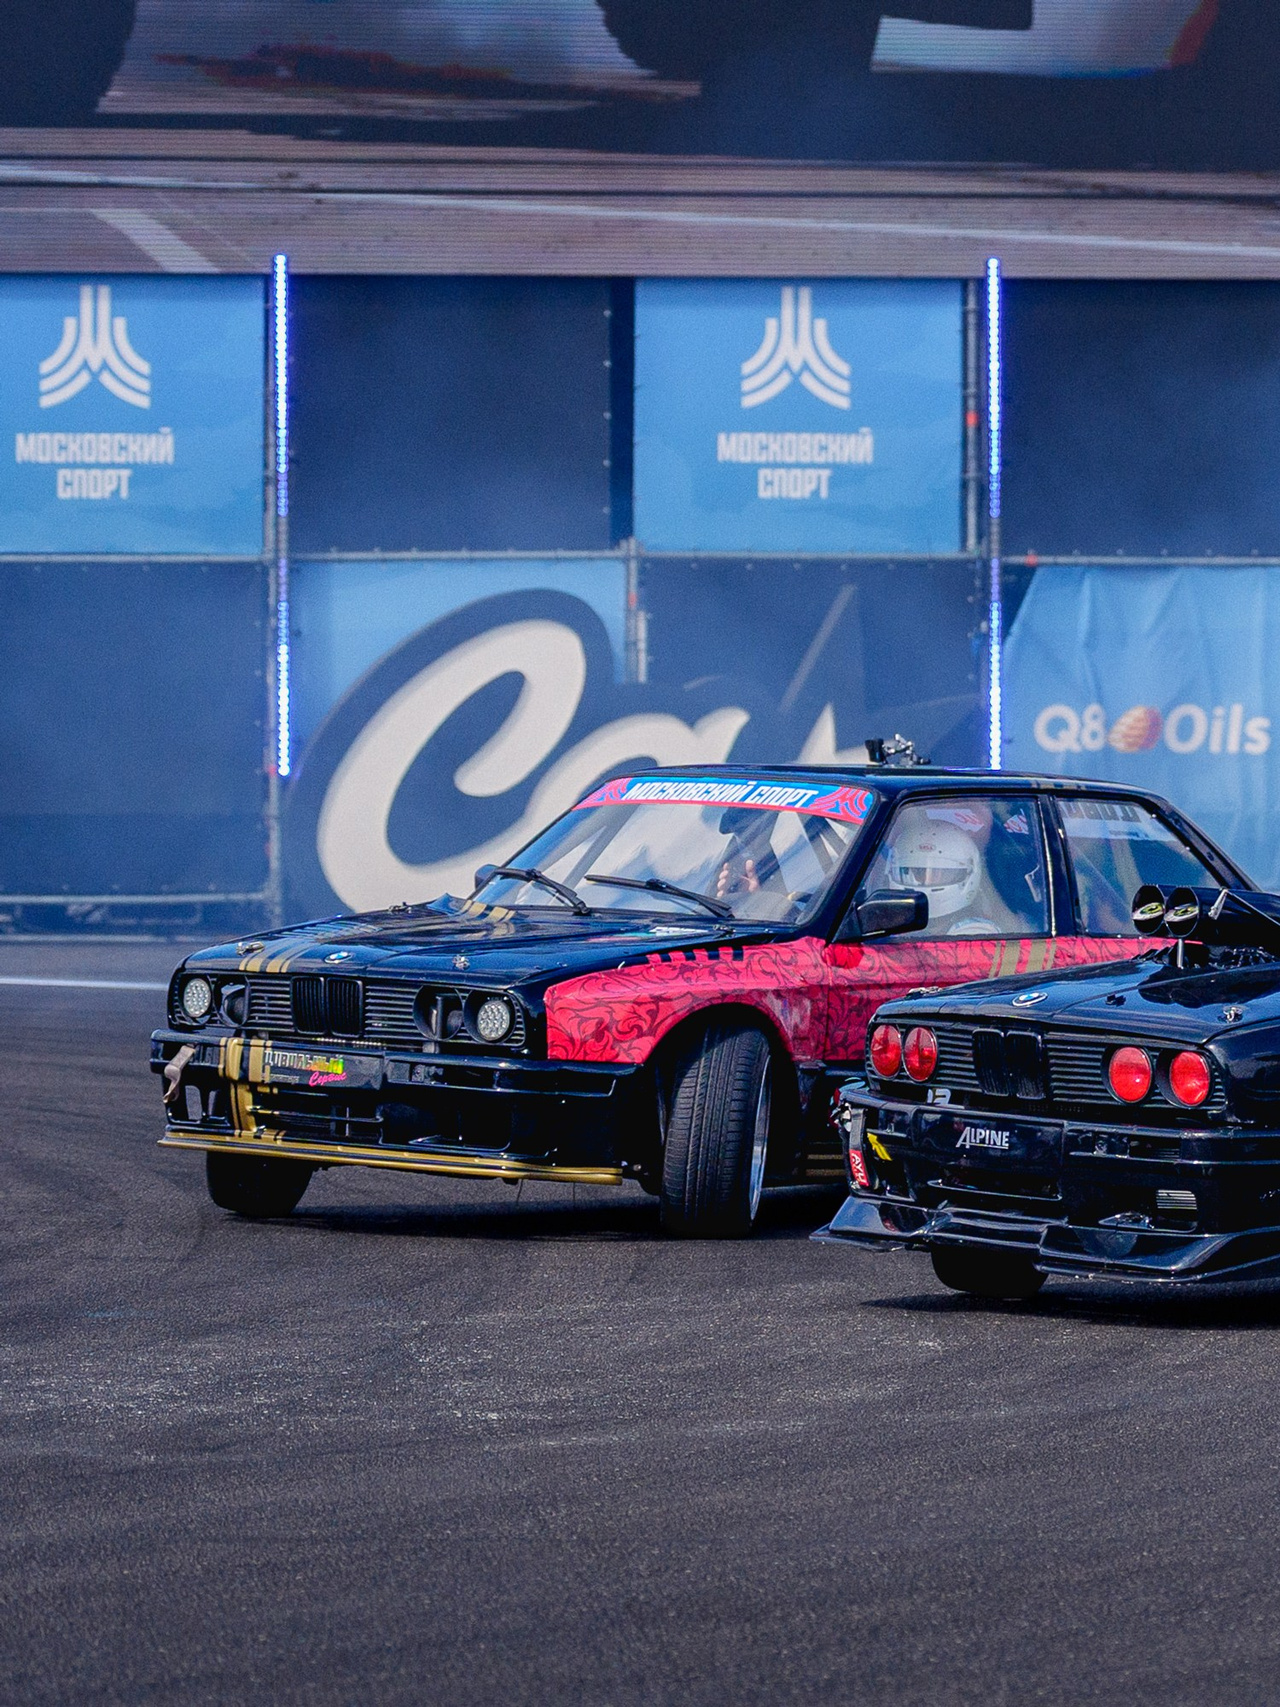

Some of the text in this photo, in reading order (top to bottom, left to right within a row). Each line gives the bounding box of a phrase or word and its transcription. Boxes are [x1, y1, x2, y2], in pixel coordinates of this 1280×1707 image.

[16, 427, 174, 464] МОСКОВСКИЙ
[717, 427, 874, 464] МОСКОВСКИЙ
[57, 469, 132, 499] СПОРТ
[757, 468, 832, 499] СПОРТ
[1034, 703, 1271, 754] Q8 Oils
[622, 781, 820, 808] МОСКОВСКИЙ СПОРТ
